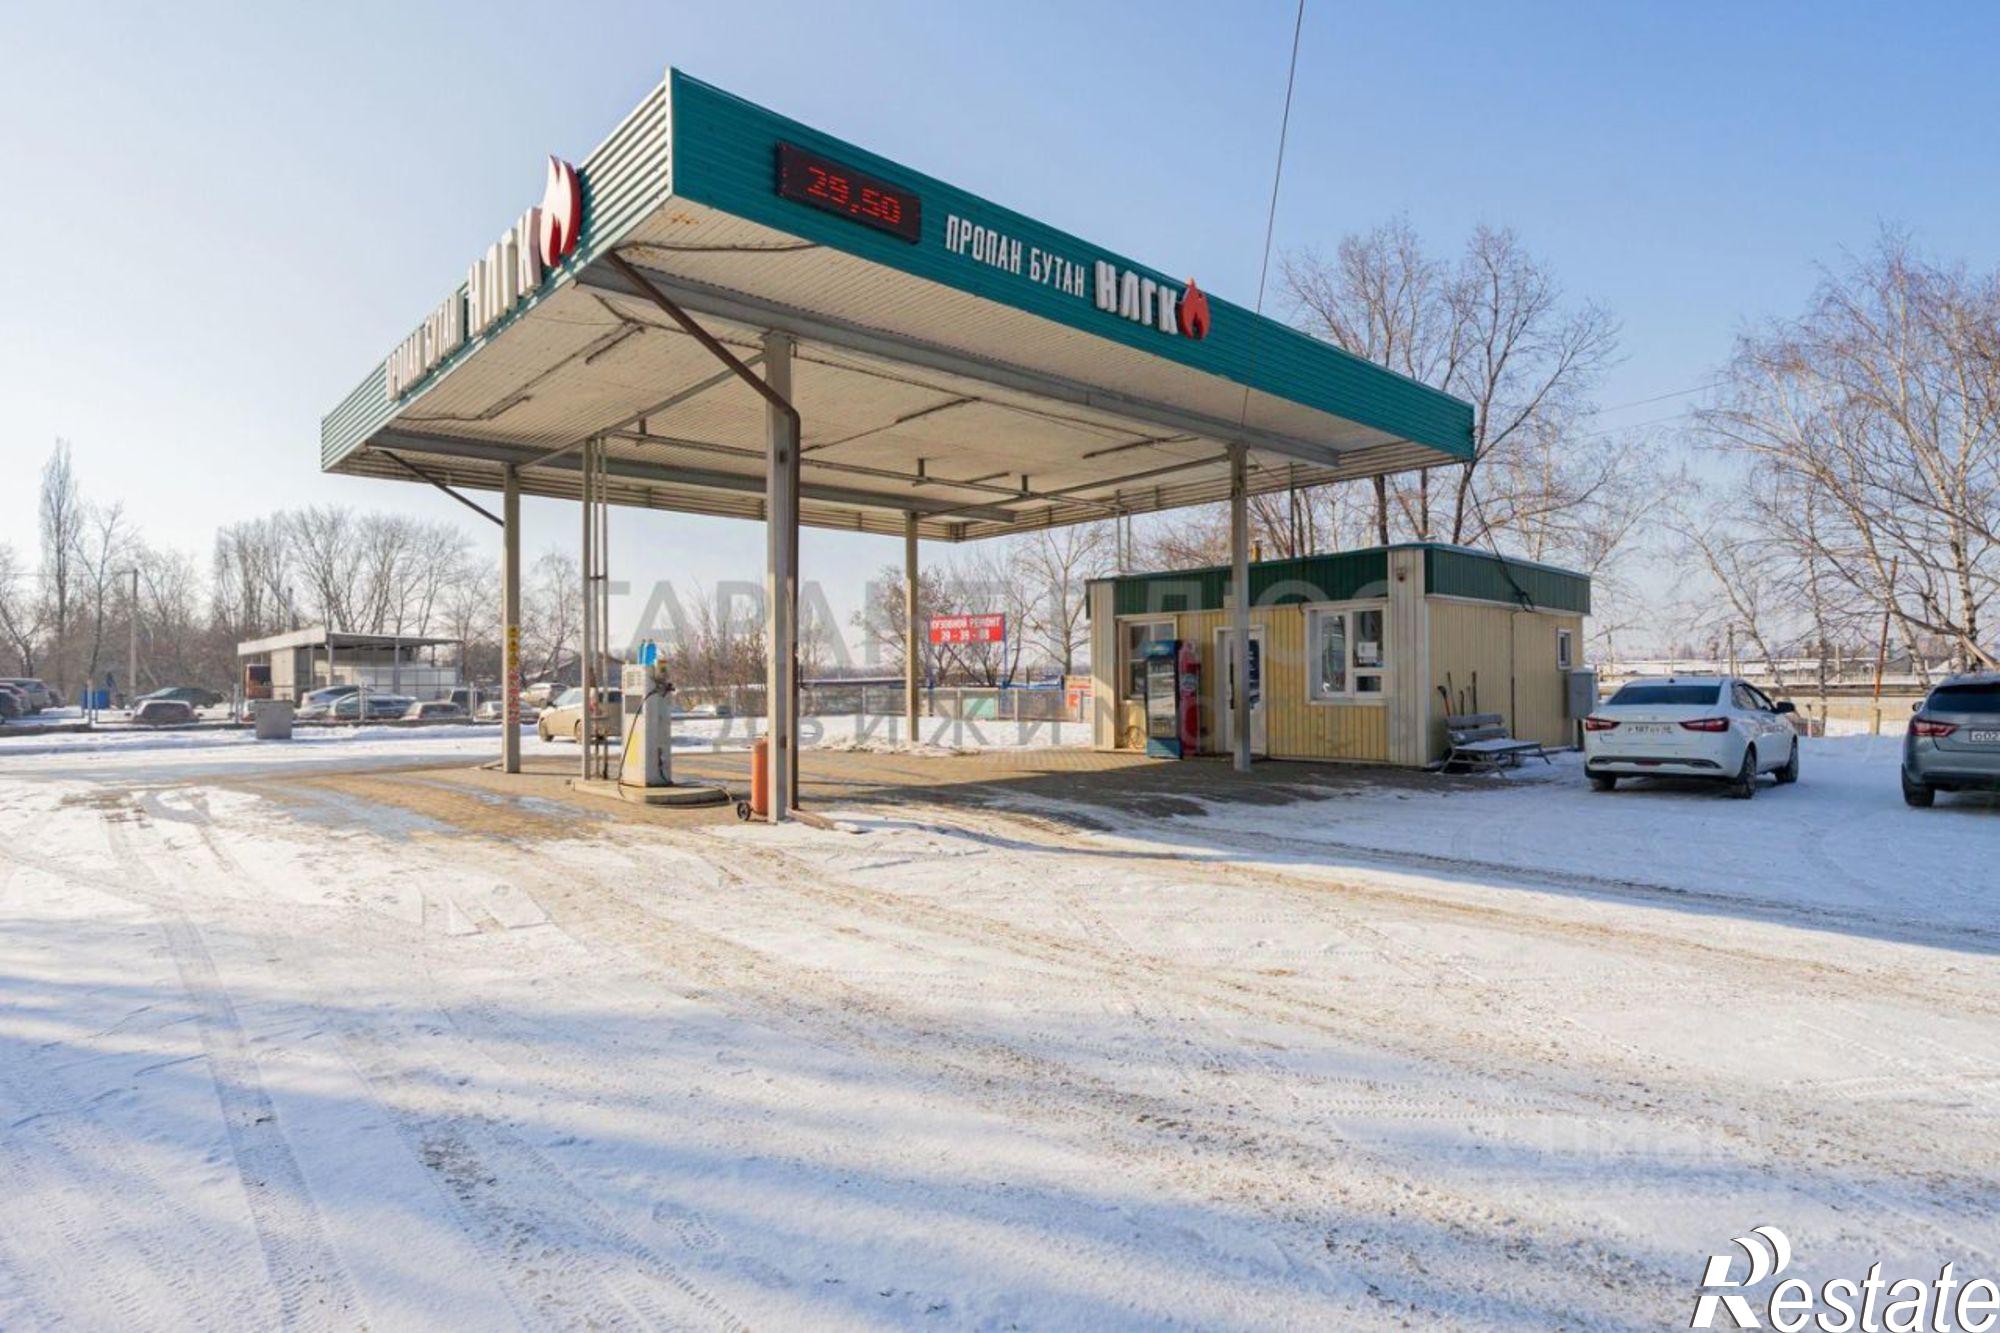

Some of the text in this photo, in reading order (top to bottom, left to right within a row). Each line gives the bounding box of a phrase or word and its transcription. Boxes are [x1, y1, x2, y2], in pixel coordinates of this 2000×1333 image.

[946, 214, 1178, 335] ПРОПАН БУТАН НЛГК
